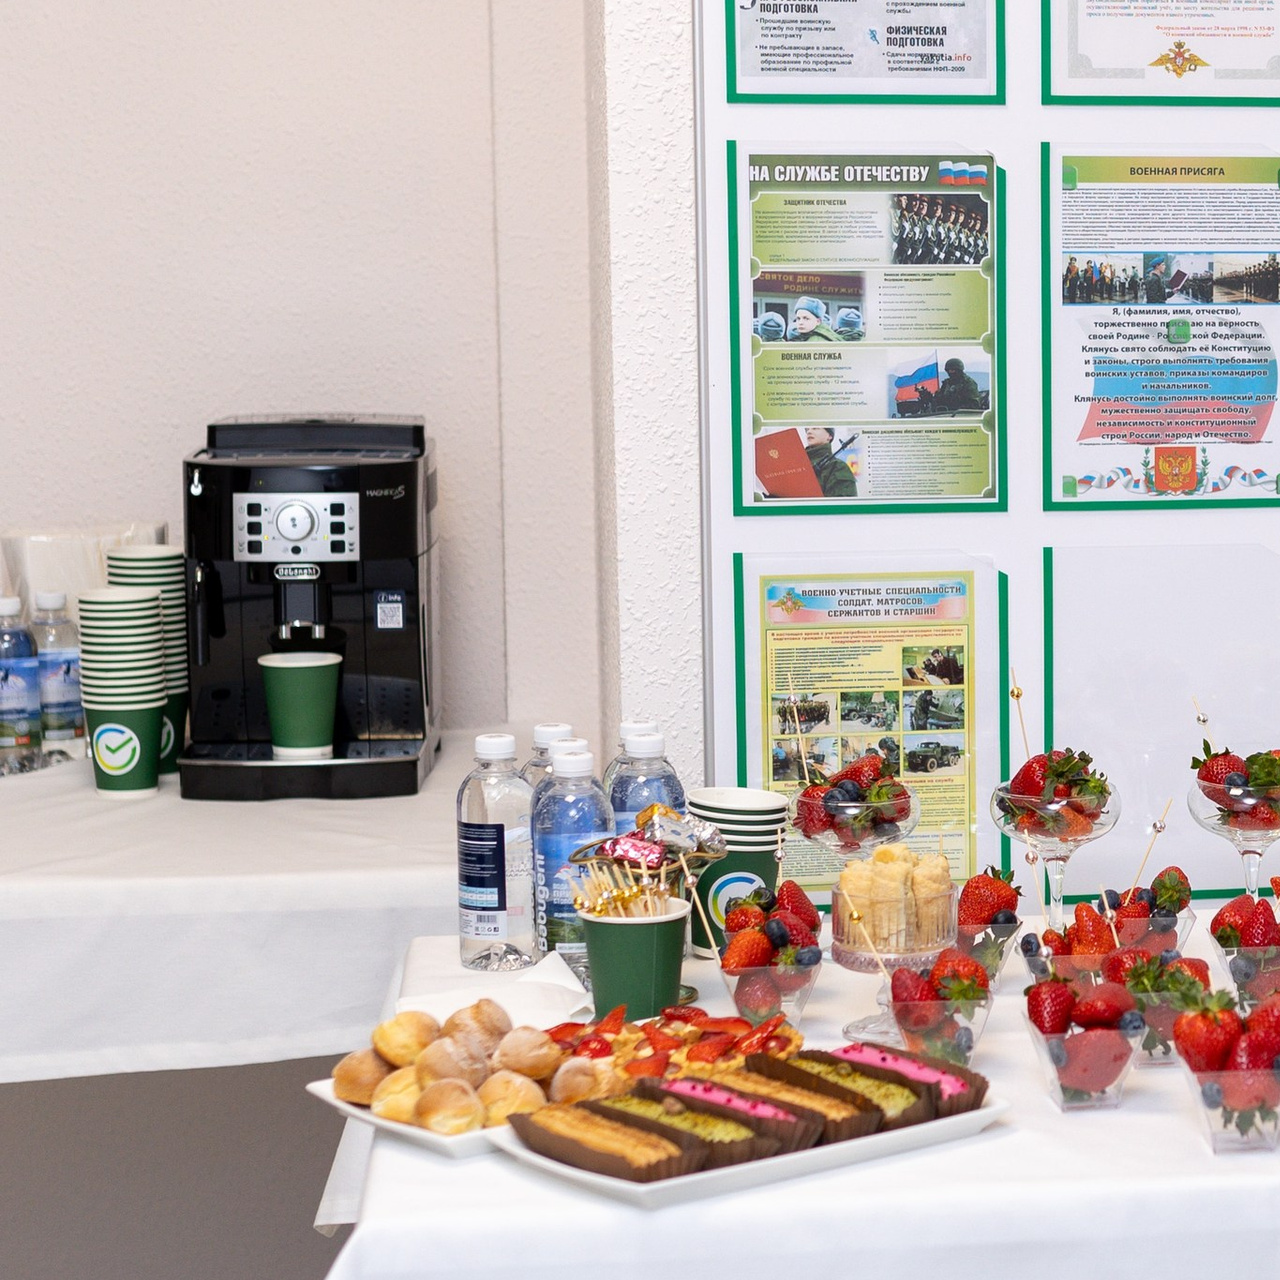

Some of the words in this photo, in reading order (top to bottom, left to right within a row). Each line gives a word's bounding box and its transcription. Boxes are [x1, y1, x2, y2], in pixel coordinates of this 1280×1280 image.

[760, 4, 818, 14] ПОДГОТОВКА
[886, 26, 946, 35] ФИЗИЧЕСКАЯ
[886, 37, 944, 47] ПОДГОТОВКА
[750, 165, 769, 181] НА
[774, 165, 839, 182] СЛУЖБЕ
[844, 166, 929, 182] ОТЕЧЕСТВУ
[1129, 166, 1177, 176] ВОЕННАЯ
[1180, 167, 1225, 177] ПРИСЯГА
[759, 272, 794, 281] СВЯТОЕ
[784, 285, 818, 293] РОДИНЕ
[1112, 307, 1120, 315] Я,
[1123, 307, 1170, 316] (фамилия,
[1116, 332, 1149, 340] Родине
[1210, 332, 1264, 341] Федерации.
[1081, 345, 1118, 354] Клянусь
[1148, 344, 1196, 353] соблюдать
[1211, 344, 1270, 353] Конституцию
[1216, 358, 1268, 366] требования
[1085, 370, 1127, 378] воинских
[1130, 370, 1167, 379] уставов,
[1074, 395, 1111, 404] Клянусь
[1113, 395, 1156, 403] достойно
[1210, 394, 1252, 403] воинский
[1255, 394, 1277, 403] долг,
[1101, 432, 1127, 440] строй
[1129, 432, 1163, 440] России,
[802, 588, 882, 597] ВОЕННО-УЧЕТНЫЕ
[886, 586, 961, 595] СПЕЦИАЛЬНОСТИ
[828, 608, 881, 617] СЕРЖАНТОВ
[893, 607, 936, 616] СТАРШИН
